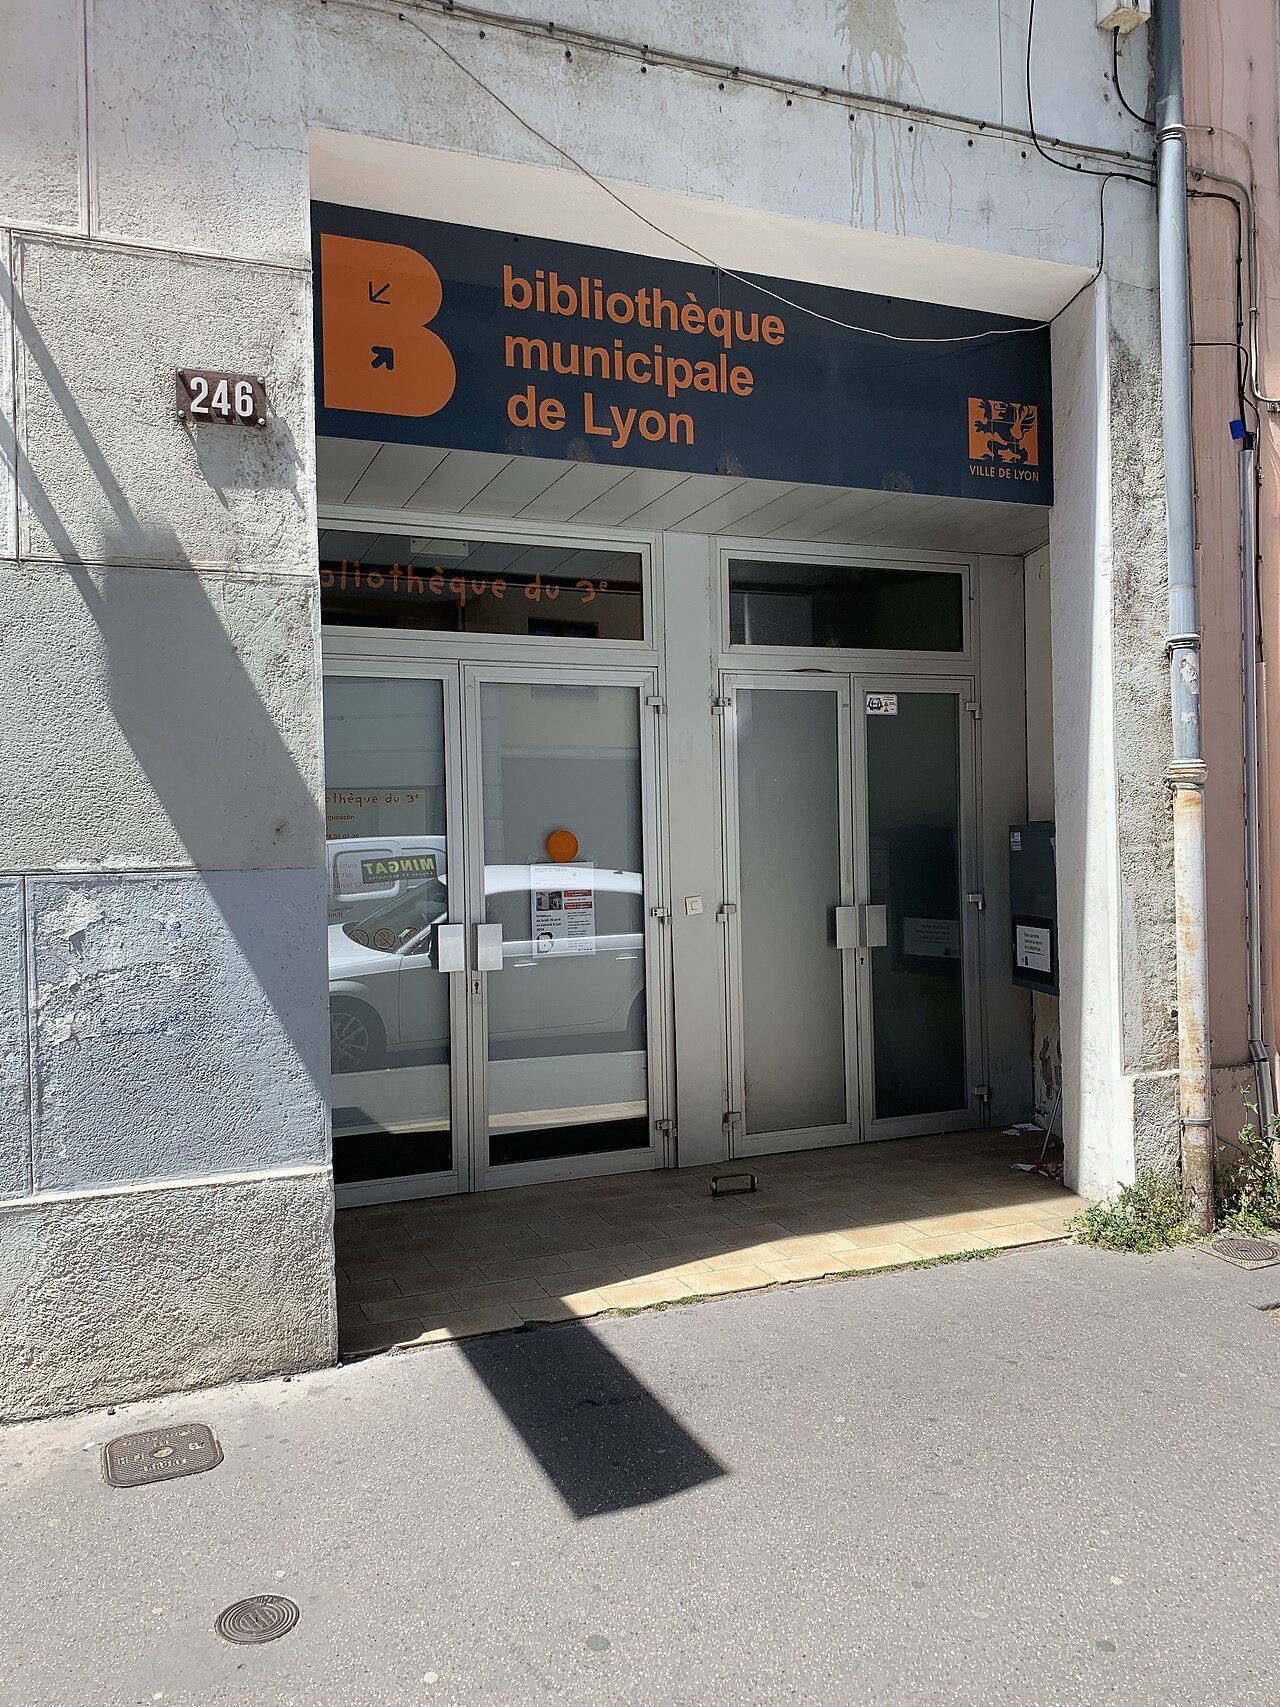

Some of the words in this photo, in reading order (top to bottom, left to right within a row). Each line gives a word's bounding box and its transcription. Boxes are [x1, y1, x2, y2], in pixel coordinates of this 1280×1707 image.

[503, 264, 786, 348] bibliothèque
[504, 333, 755, 398] municipale
[190, 376, 254, 417] 246
[507, 385, 566, 432] de
[583, 391, 696, 449] Lyon
[969, 464, 995, 477] VILLE
[998, 467, 1011, 479] DE
[1014, 469, 1039, 481] LYON
[524, 572, 560, 601] du
[385, 792, 400, 804] du
